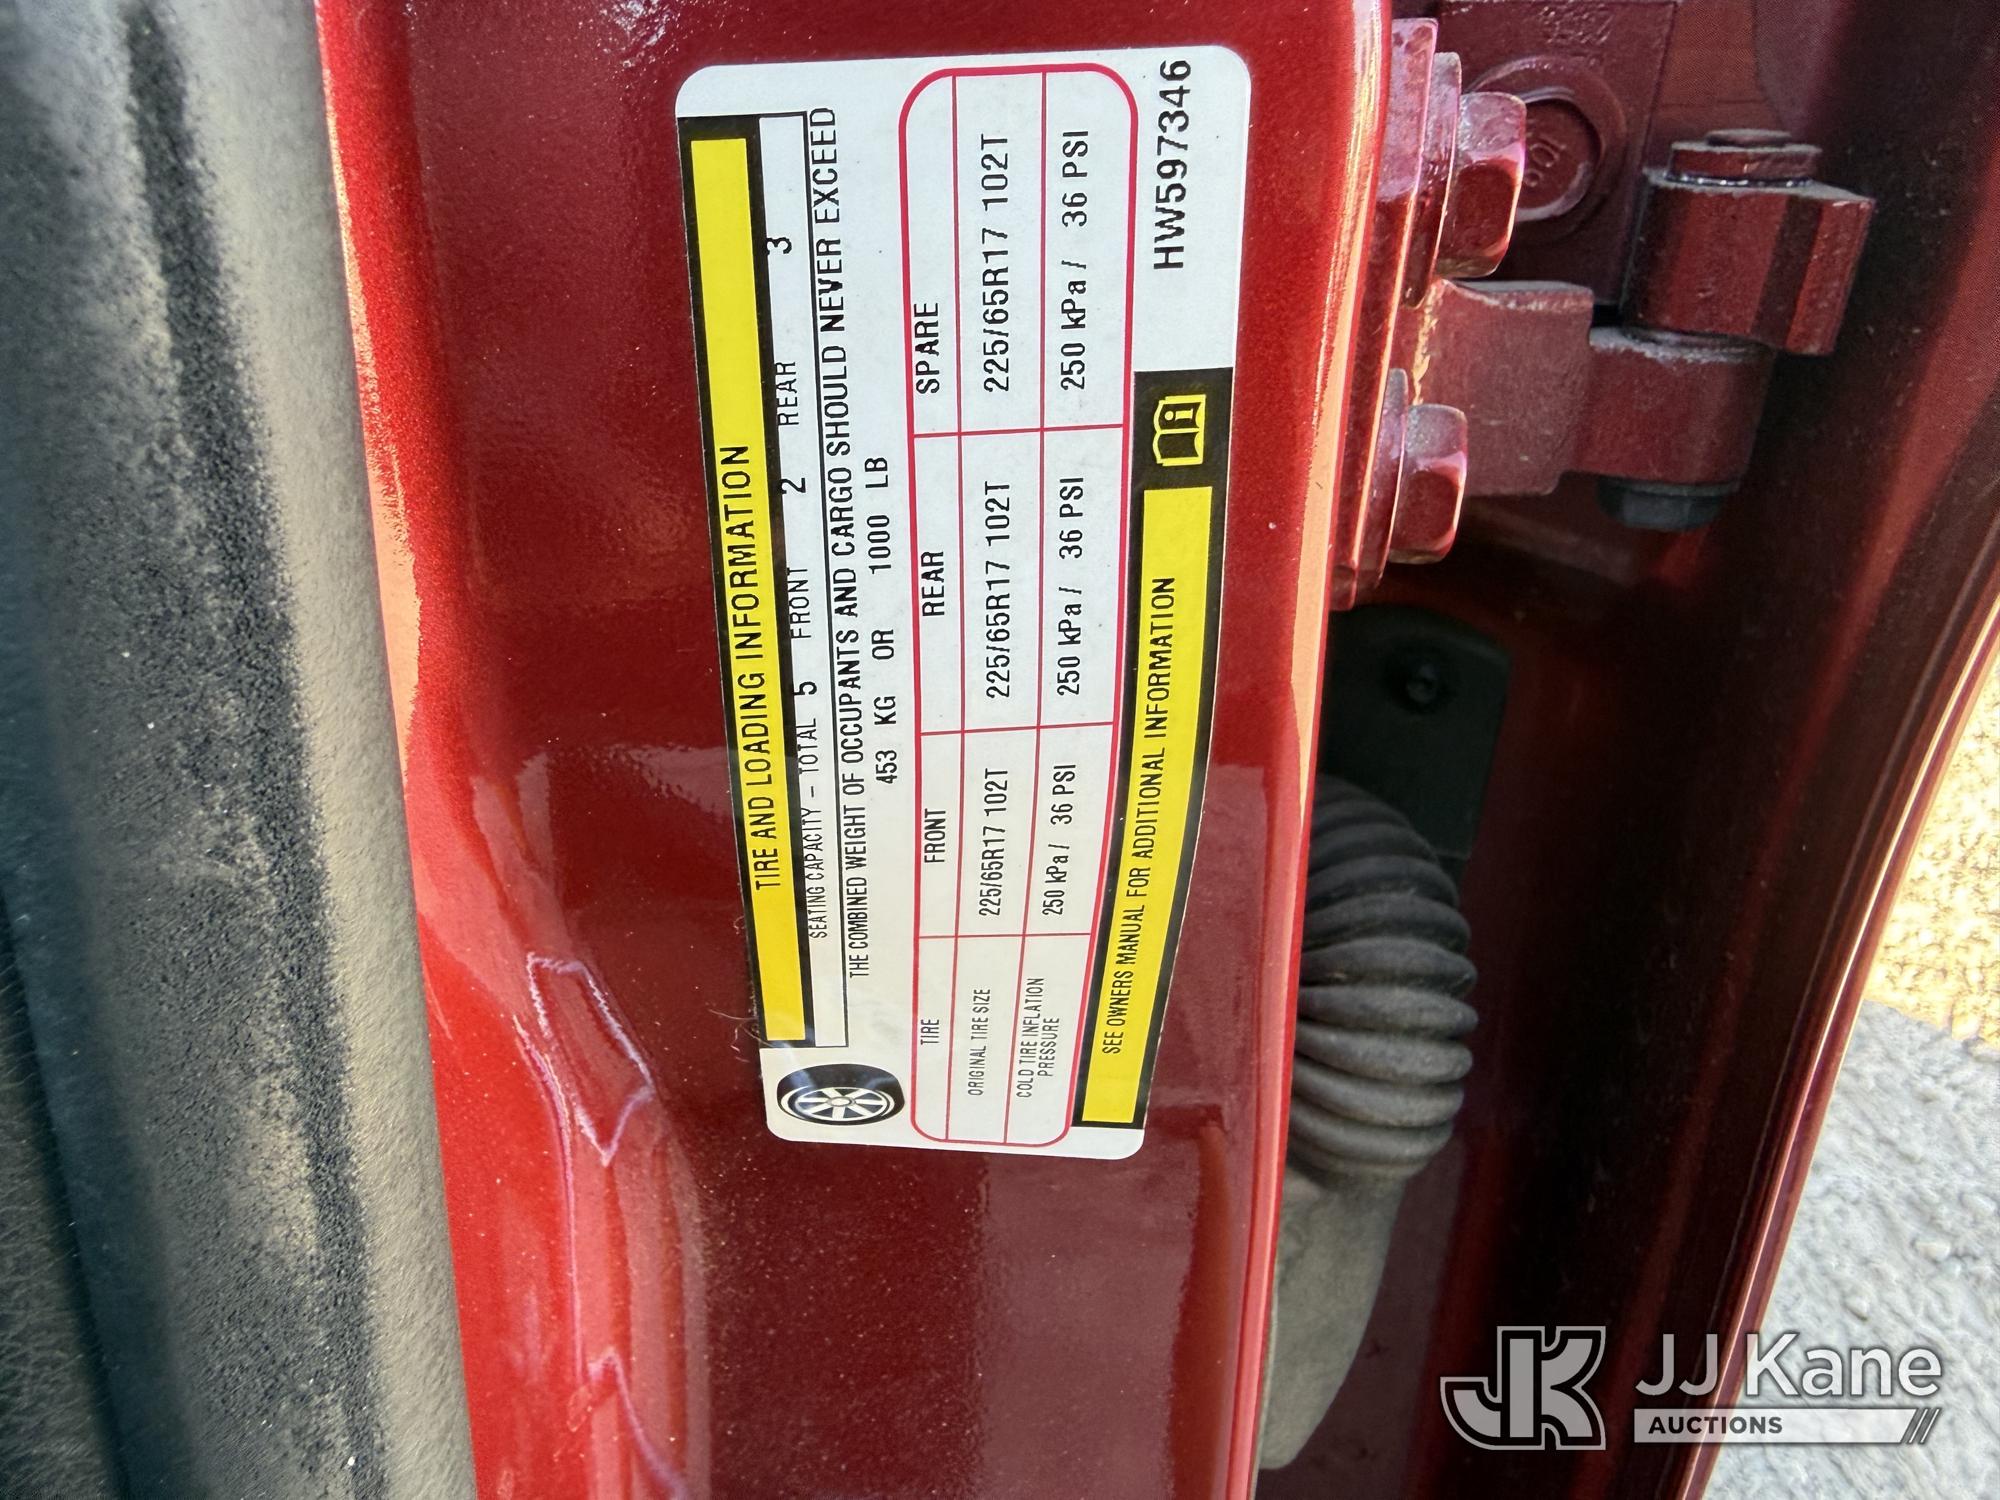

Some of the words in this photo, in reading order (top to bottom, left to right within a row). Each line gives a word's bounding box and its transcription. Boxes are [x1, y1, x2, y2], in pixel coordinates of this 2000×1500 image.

[810, 108, 840, 223] EXCEED
[980, 134, 1008, 210] 102T
[1062, 130, 1088, 178] PSI
[1154, 60, 1190, 269] HW597346
[1062, 192, 1088, 226] 36
[766, 237, 792, 254] 3
[816, 239, 844, 332] NEVER
[1062, 280, 1086, 328] kPa
[982, 228, 1009, 392] 225/65R17
[914, 303, 940, 394] SPARE
[1061, 343, 1086, 390] 250
[776, 362, 798, 425] REAR
[821, 346, 852, 456] SHOULD
[780, 478, 806, 494] 2
[865, 458, 889, 488] LB
[828, 468, 855, 556] CARGO
[985, 481, 1010, 546] 102T
[1060, 478, 1083, 517] PSI
[720, 446, 762, 659] INFORMATION
[867, 515, 891, 574] 1000
[1059, 530, 1082, 559] 36
[787, 567, 811, 639] FRONT
[833, 569, 858, 617] AND
[921, 551, 944, 616] REAR
[872, 629, 895, 660] OR
[986, 560, 1010, 698] 225/65R17
[1058, 604, 1081, 645] kPa
[1058, 656, 1080, 695] 250
[1144, 578, 1175, 737] INFORMATION
[792, 681, 817, 696] 5
[836, 630, 864, 763] OCCUPANTS
[874, 696, 896, 726] KG
[737, 673, 773, 785] LOADING
[796, 718, 818, 773] TOTAL
[843, 773, 864, 794] OF
[875, 750, 898, 784] 453
[1052, 764, 1076, 794] PSI
[984, 768, 1008, 816] 102T
[1050, 804, 1073, 824] 36
[1132, 748, 1165, 858] ADDITIONAL
[748, 797, 777, 839] AND
[844, 806, 866, 870] WEIGHT
[924, 808, 946, 862] FRONT
[801, 808, 824, 880] CAPACITY
[752, 848, 780, 889] TIRE
[979, 826, 1006, 916] 225/65R17
[1046, 856, 1069, 883] kPa
[1127, 868, 1150, 897] FOR
[806, 886, 827, 938] SEATING
[848, 878, 868, 949] COMBINED
[1042, 890, 1065, 915] 250
[1118, 905, 1144, 964] MANUAL
[850, 954, 868, 978] THE
[972, 989, 990, 1013] SIZE
[1022, 978, 1044, 1038] INFLATION
[1105, 971, 1133, 1026] OWNERS
[920, 1018, 940, 1045] TIRE
[970, 1018, 988, 1040] TIRE
[1020, 1041, 1038, 1064] TIRE
[1038, 1017, 1059, 1076] PRESSURE
[1102, 1032, 1123, 1054] SEE
[968, 1046, 986, 1096] ORIGINAL
[1017, 1070, 1036, 1098] COLD
